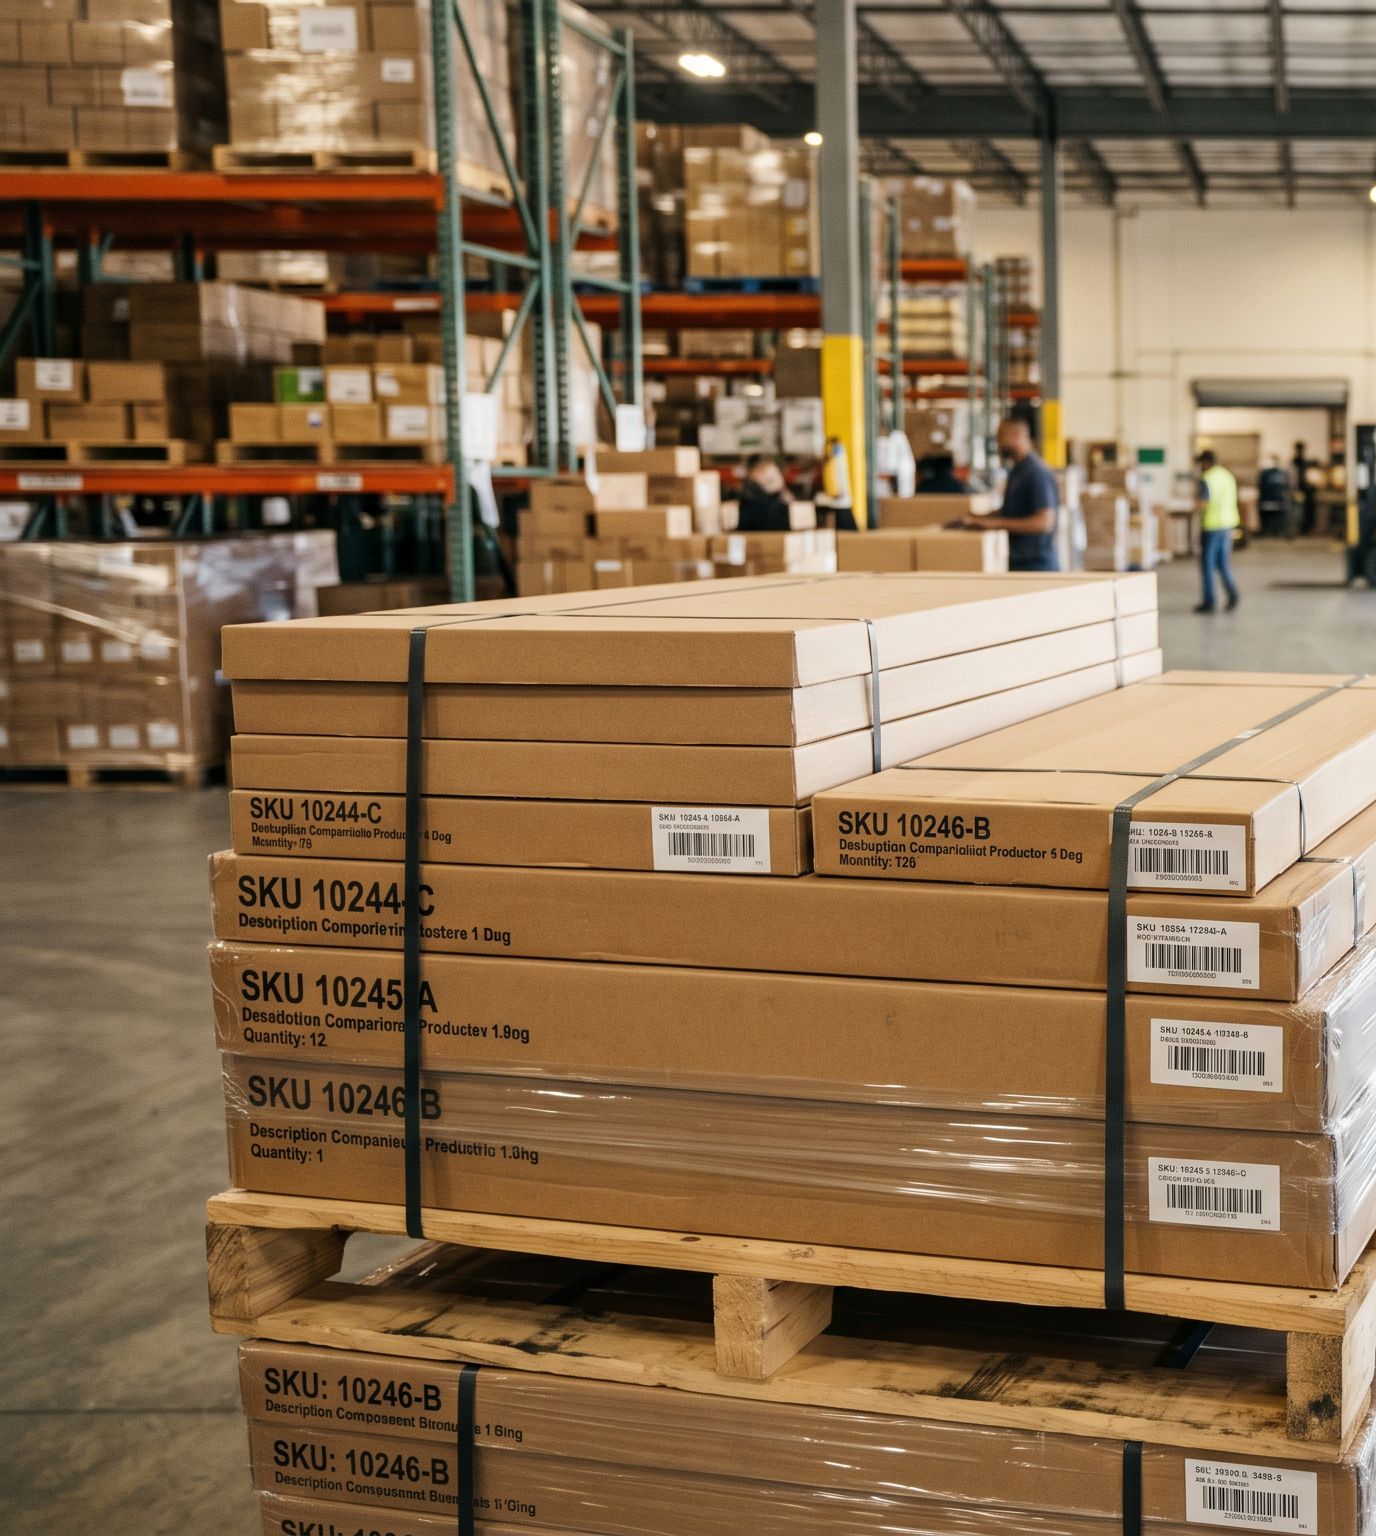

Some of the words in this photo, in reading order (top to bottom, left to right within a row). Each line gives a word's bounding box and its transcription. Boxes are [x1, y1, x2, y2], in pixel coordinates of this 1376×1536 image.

[250, 797, 293, 820] SKU
[301, 800, 382, 824] 10244-C
[838, 811, 888, 836] SKU
[897, 813, 990, 840] 10246-B
[238, 875, 301, 909] SKU
[1137, 924, 1156, 932] SKU
[242, 969, 303, 1004] SKU
[316, 974, 438, 1013] 10245A
[244, 1027, 306, 1049] Quantity:
[309, 1033, 328, 1047] 12
[248, 1075, 310, 1110] SKU
[322, 1081, 442, 1120] 10246B
[250, 1122, 328, 1143] Description
[251, 1144, 312, 1164] Quantity:
[316, 1150, 324, 1162] 1
[264, 1367, 328, 1400] SKU:
[338, 1376, 442, 1412] 10246-B
[266, 1399, 333, 1418] Description
[273, 1440, 336, 1472] SKU:
[345, 1449, 449, 1486] 10246-B
[275, 1471, 342, 1492] Description
[280, 1519, 343, 1536] SK
